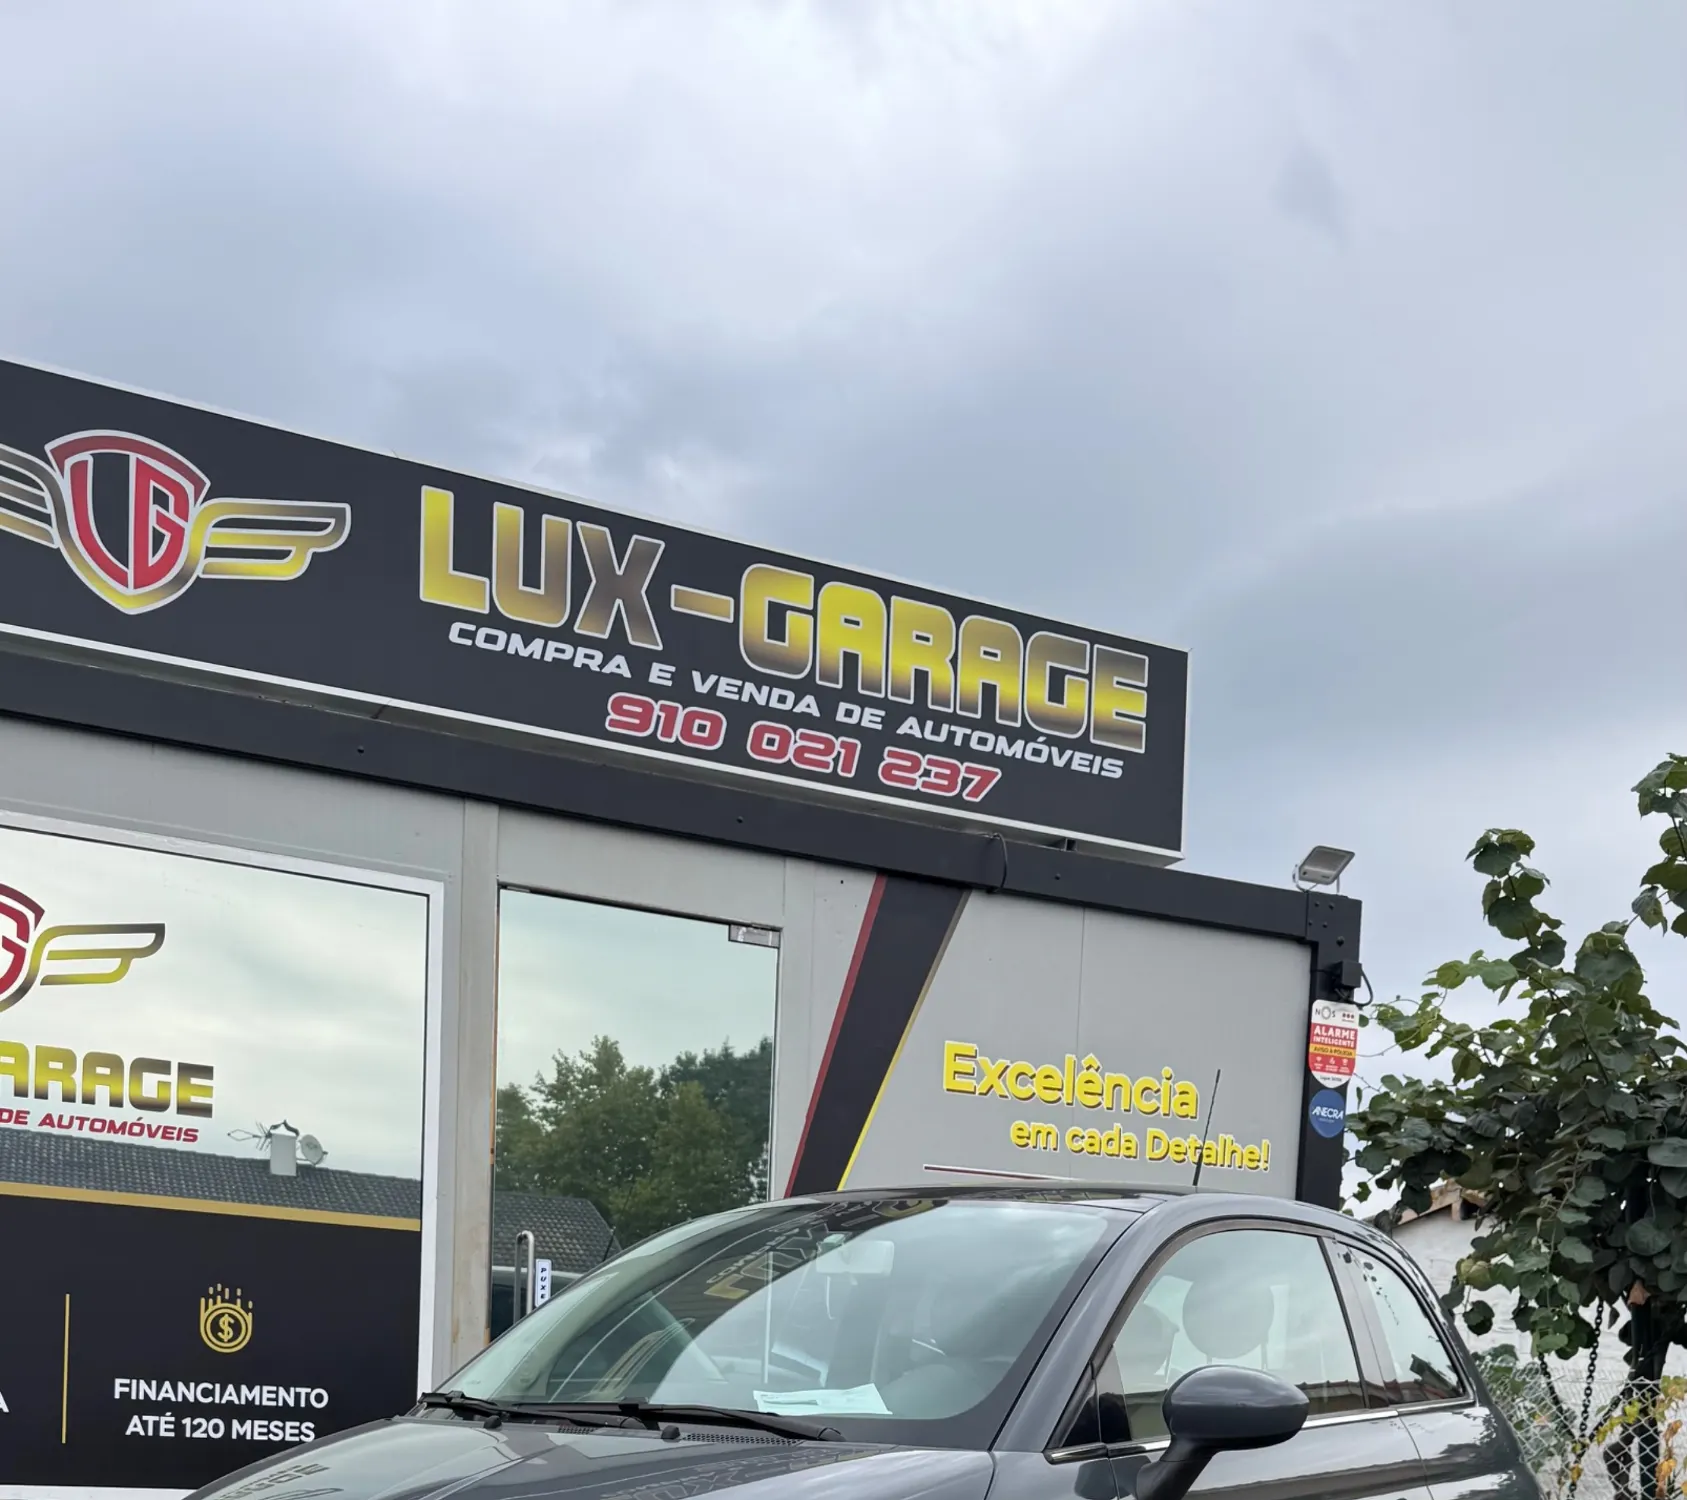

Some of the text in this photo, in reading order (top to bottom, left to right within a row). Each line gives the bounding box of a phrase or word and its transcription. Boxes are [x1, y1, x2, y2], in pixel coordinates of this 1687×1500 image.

[420, 485, 1149, 754] LUX-GARAGE
[448, 622, 1125, 780] COMPRA E VENDA DE AUTOMÓVEIS
[605, 692, 1002, 802] 910 021 237
[1314, 1025, 1356, 1040] ALARME
[943, 1041, 1199, 1120] Excelência
[38, 1112, 199, 1143] AUTOMÓVEIS
[1010, 1120, 1271, 1171] em cada Detalhe!
[114, 1378, 329, 1409] FINANCIAMENTO
[125, 1412, 316, 1443] ATÉ 120 MESES
